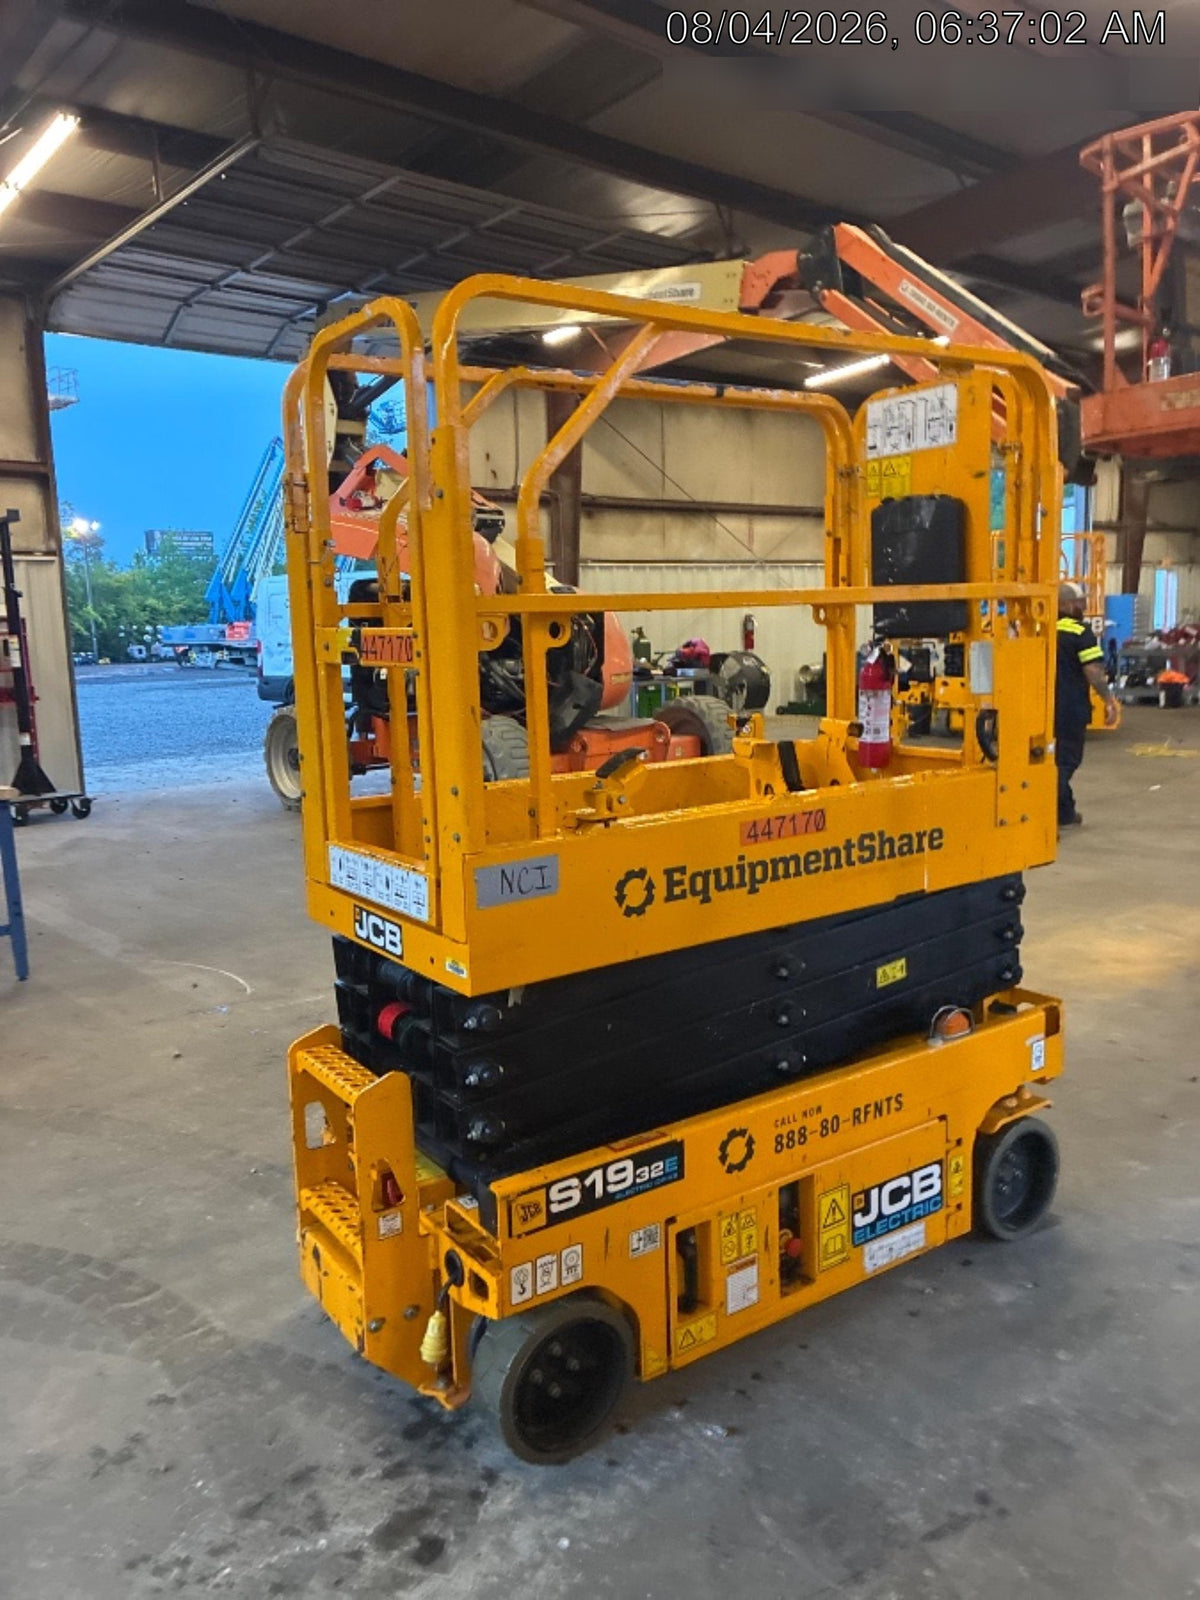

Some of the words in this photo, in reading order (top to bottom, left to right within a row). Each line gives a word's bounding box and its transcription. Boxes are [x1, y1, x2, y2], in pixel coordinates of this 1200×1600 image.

[362, 635, 413, 662] 447170
[746, 808, 826, 843] 447170
[500, 865, 551, 895] NCI
[664, 826, 944, 904] EquipmentShare
[355, 909, 402, 956] JCB
[774, 1113, 797, 1128] CALL
[854, 1163, 941, 1227] JCB
[853, 1196, 942, 1247] ELECTRIC
